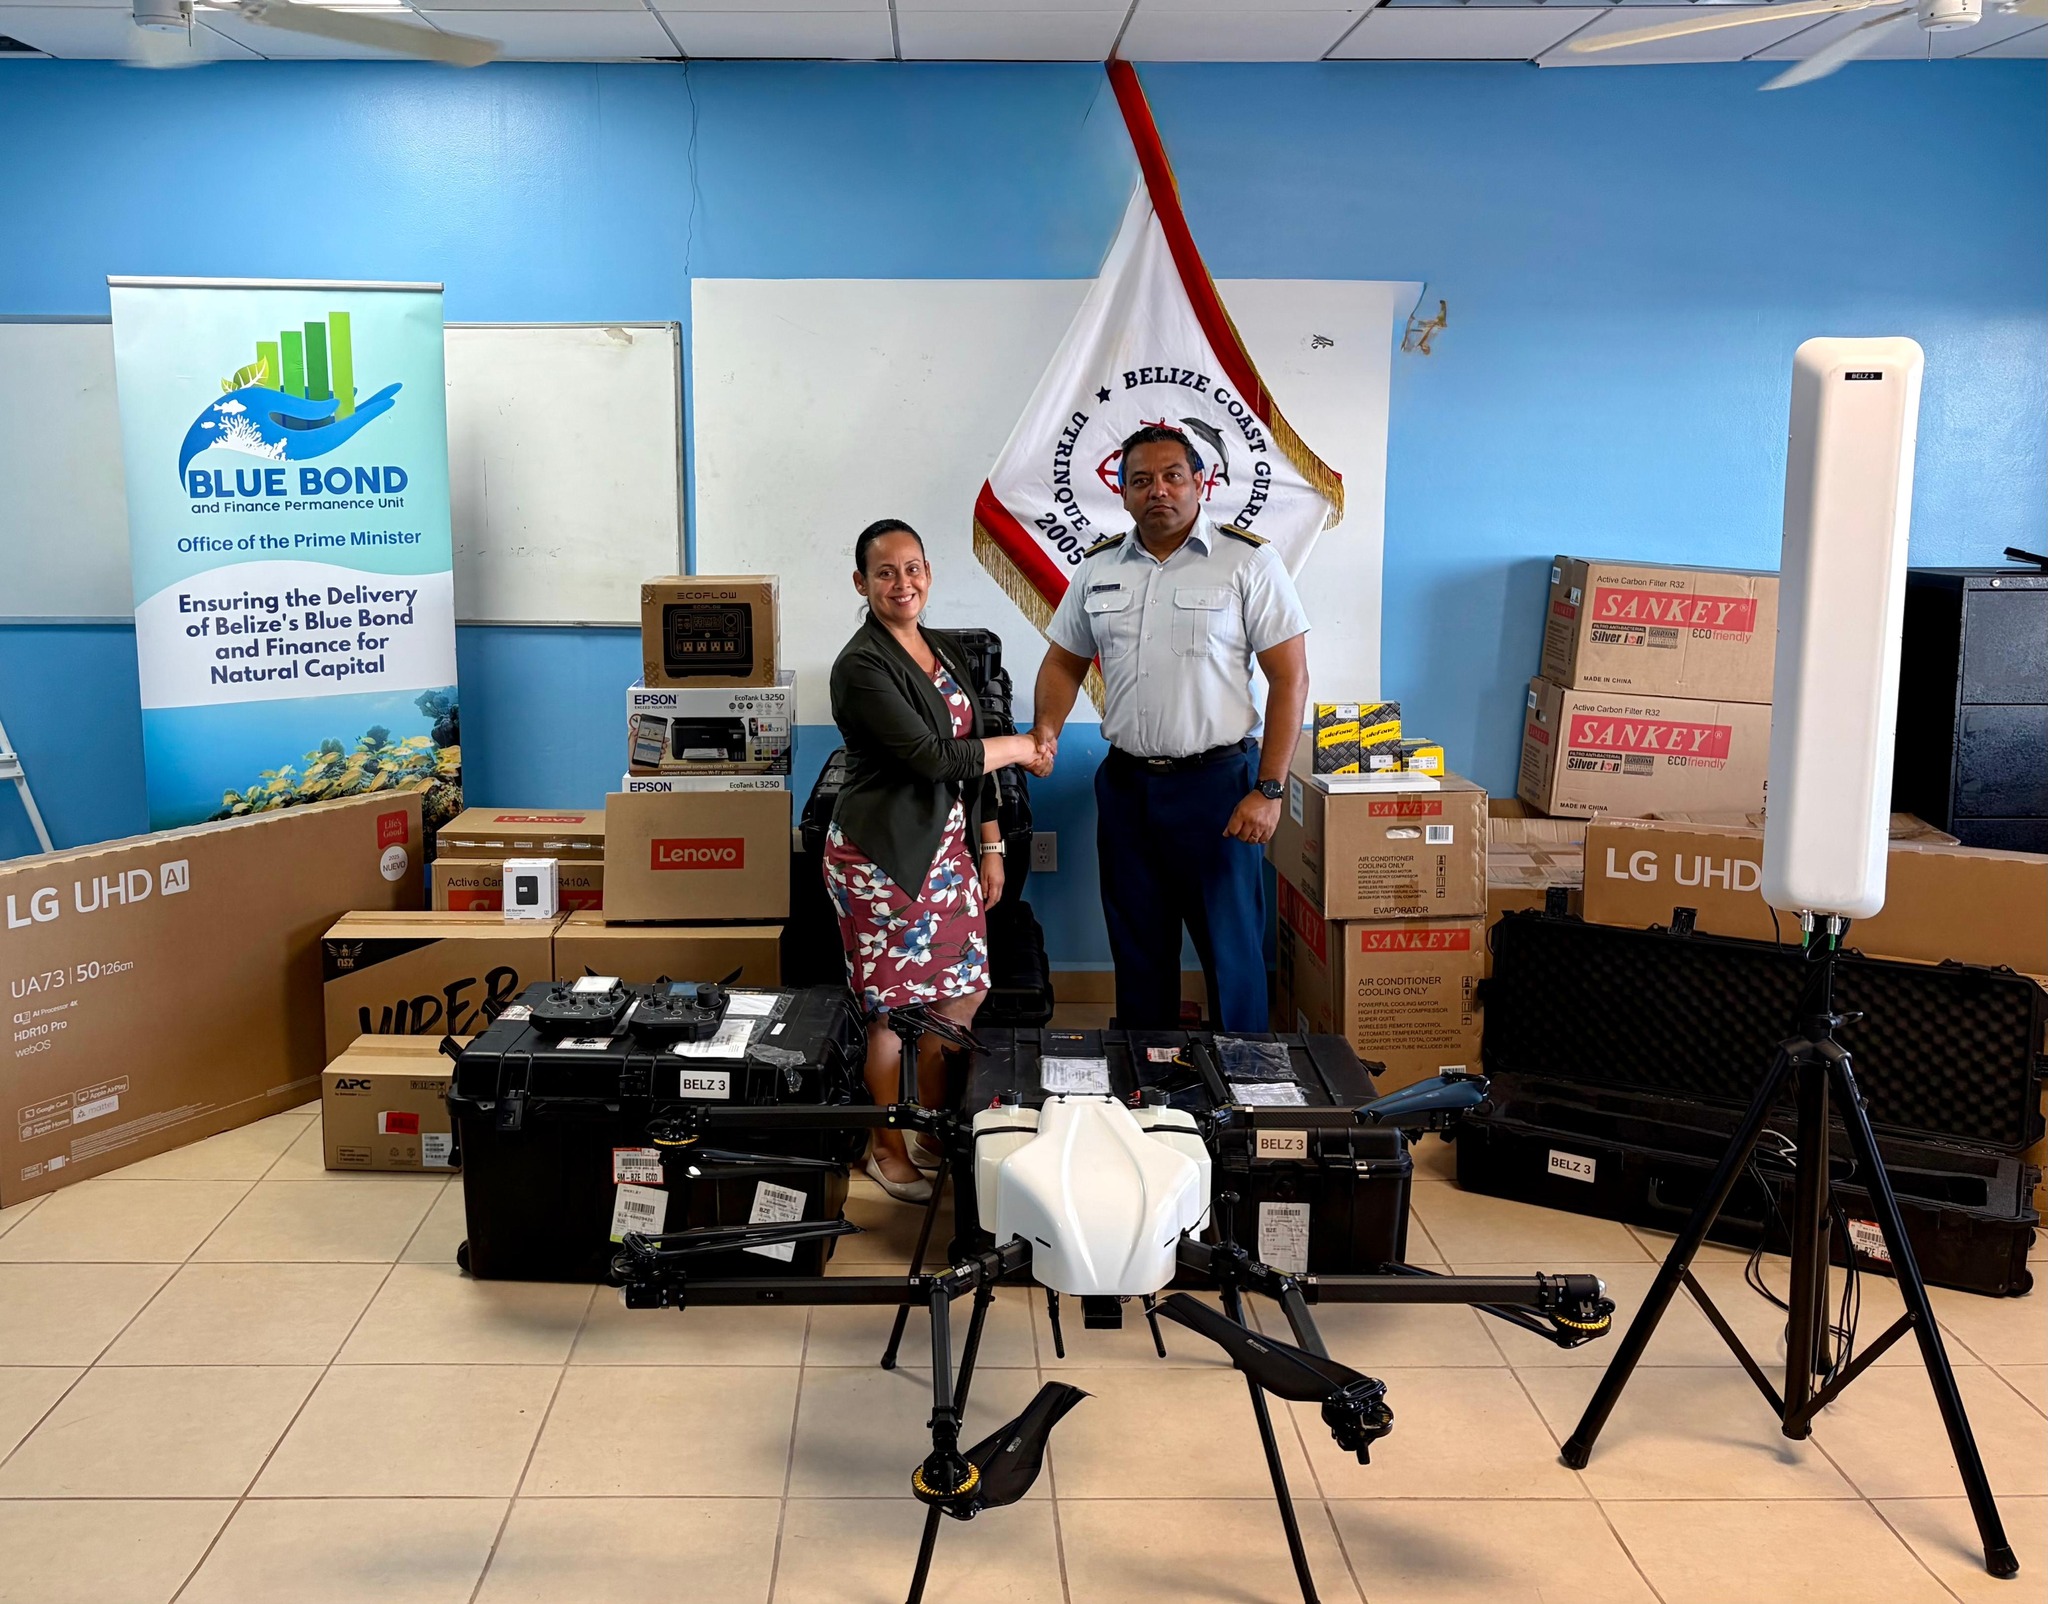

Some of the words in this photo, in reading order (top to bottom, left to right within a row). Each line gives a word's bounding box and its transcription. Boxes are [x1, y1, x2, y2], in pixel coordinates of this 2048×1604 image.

[1122, 367, 1211, 393] BELIZE
[1214, 388, 1266, 452] COAST
[1053, 411, 1091, 531] UTRINQUE
[188, 468, 287, 498] BLUE
[299, 466, 408, 496] BOND
[1233, 461, 1271, 530] GUARD
[191, 502, 220, 514] and
[224, 501, 281, 513] Finance
[285, 498, 374, 511] Permanence
[379, 497, 404, 508] Unit
[177, 536, 233, 553] Office
[237, 535, 256, 550] of
[260, 534, 290, 549] the
[294, 532, 346, 548] Prime
[351, 531, 422, 546] Minister
[1034, 512, 1086, 565] 2005
[1597, 575, 1619, 584] Active
[1620, 577, 1647, 586] Carbon
[1649, 579, 1667, 587] Filter
[1669, 580, 1684, 588] R32
[179, 591, 279, 613] Ensuring
[285, 588, 321, 607] the
[327, 585, 418, 606] Delivery
[677, 592, 737, 600] ECOFLOW
[186, 616, 209, 637] of
[216, 613, 299, 635] Belize's
[305, 611, 352, 630] Blue
[358, 607, 414, 627] Bond
[1592, 630, 1621, 642] Silver
[215, 639, 260, 659] and
[266, 637, 351, 657] Finance
[357, 632, 389, 650] for
[211, 659, 298, 684] Natural
[304, 654, 385, 680] Capital
[634, 694, 677, 704] EPSON
[1573, 704, 1595, 712] Active
[1597, 705, 1622, 714] Carbon
[1625, 707, 1642, 716] Filter
[1645, 709, 1660, 717] R32
[1568, 758, 1598, 769] Silver
[630, 782, 672, 792] EPSON
[1588, 804, 1608, 812] CHINA
[384, 818, 402, 829] Life's
[383, 827, 404, 838] Good.
[660, 846, 736, 862] Lenovo
[382, 861, 406, 872] NUEVO
[1606, 848, 1658, 881] LG
[1674, 854, 1762, 892] UHD
[448, 877, 479, 887] Active
[6, 887, 60, 929] LG
[74, 869, 153, 913] UHD
[164, 866, 187, 889] AI
[1373, 906, 1428, 914] EVAPORATOR
[11, 969, 65, 998] UA73
[77, 961, 100, 982] 50
[1358, 978, 1374, 986] AIR
[1376, 977, 1442, 986] CONDITIONER
[1358, 988, 1400, 996] COOLING
[1403, 987, 1428, 995] ONLY
[14, 1024, 48, 1042] HDR10
[51, 1021, 67, 1031] Pro
[15, 1039, 51, 1057] webOS
[335, 1079, 371, 1089] APC
[683, 1079, 715, 1091] BELZ
[718, 1079, 726, 1091] 3
[36, 1104, 54, 1114] Google
[1261, 1139, 1292, 1149] BELZ
[1296, 1140, 1303, 1150] 3
[1552, 1157, 1580, 1172] BELZ
[1584, 1165, 1590, 1174] 3
